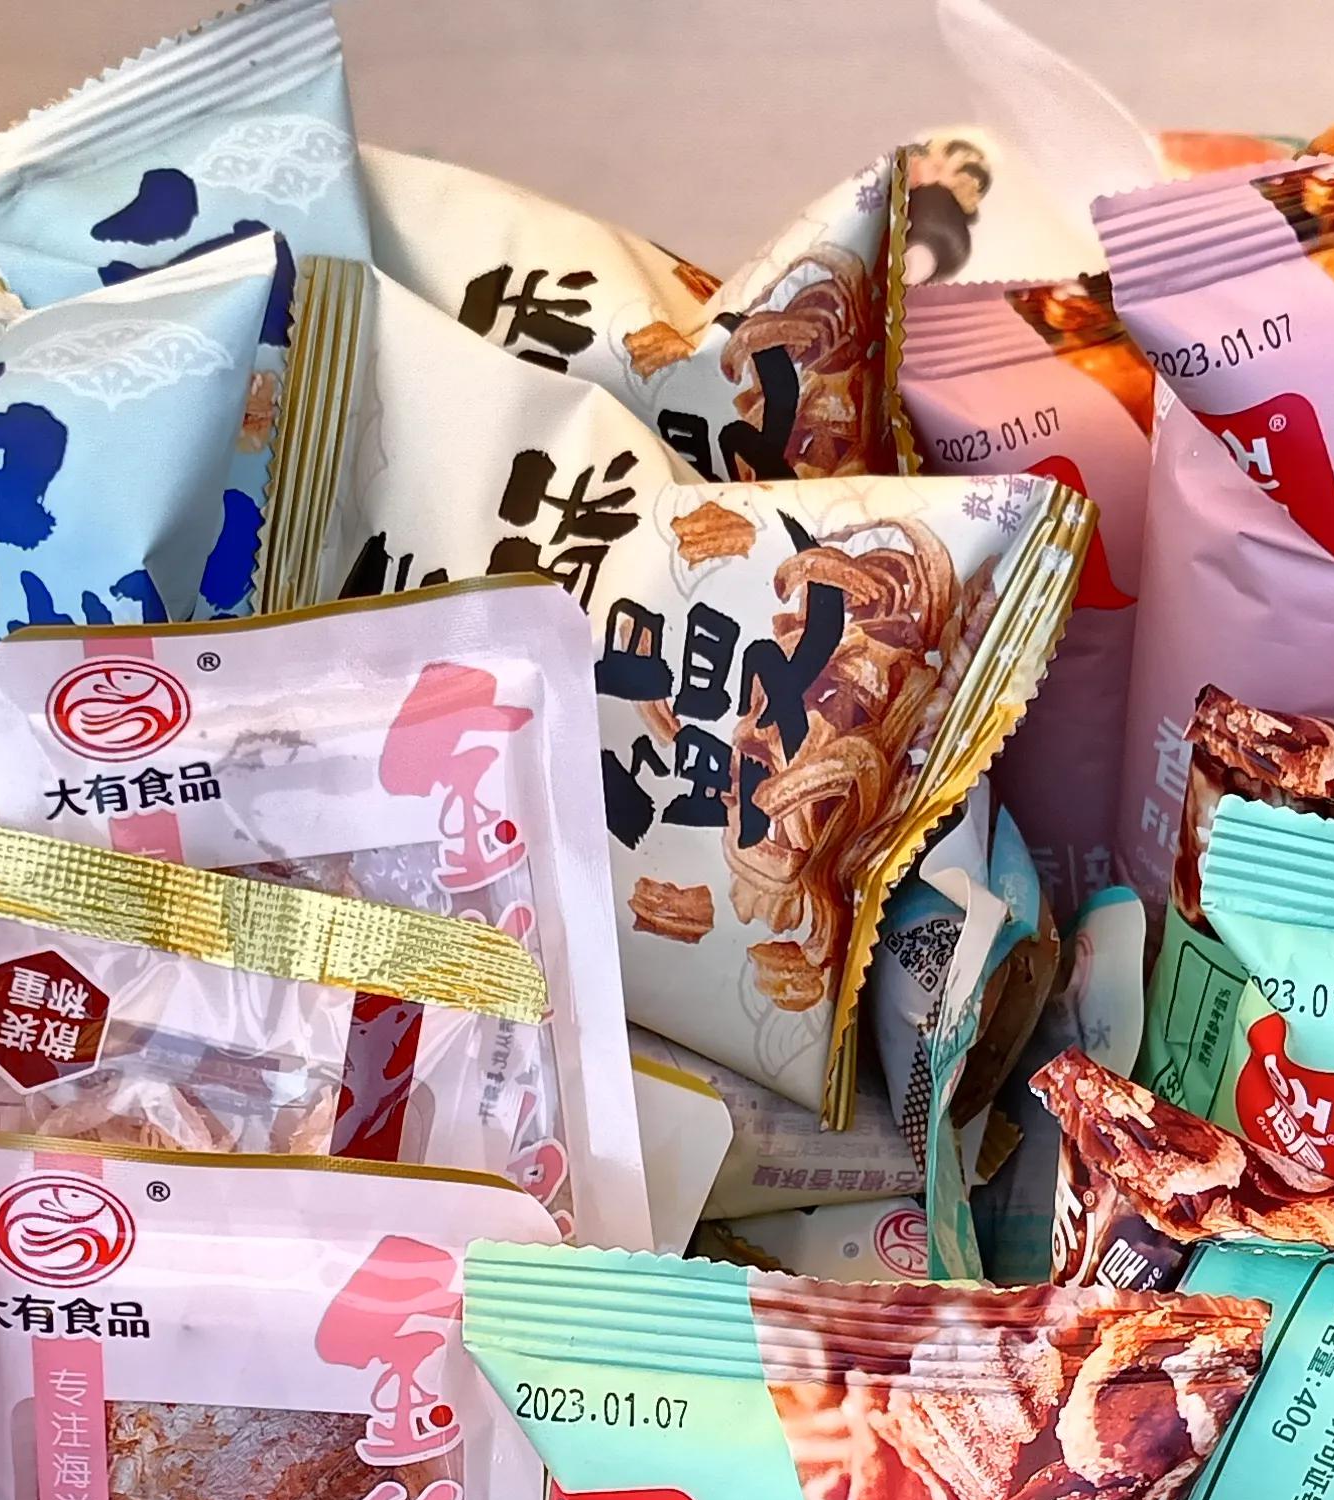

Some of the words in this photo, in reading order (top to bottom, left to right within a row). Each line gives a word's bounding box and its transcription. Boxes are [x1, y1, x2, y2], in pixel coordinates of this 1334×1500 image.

[935, 406, 1062, 465] 2023.01.07
[44, 761, 221, 821] 大有食品
[515, 1381, 688, 1429] 2023.01.07
